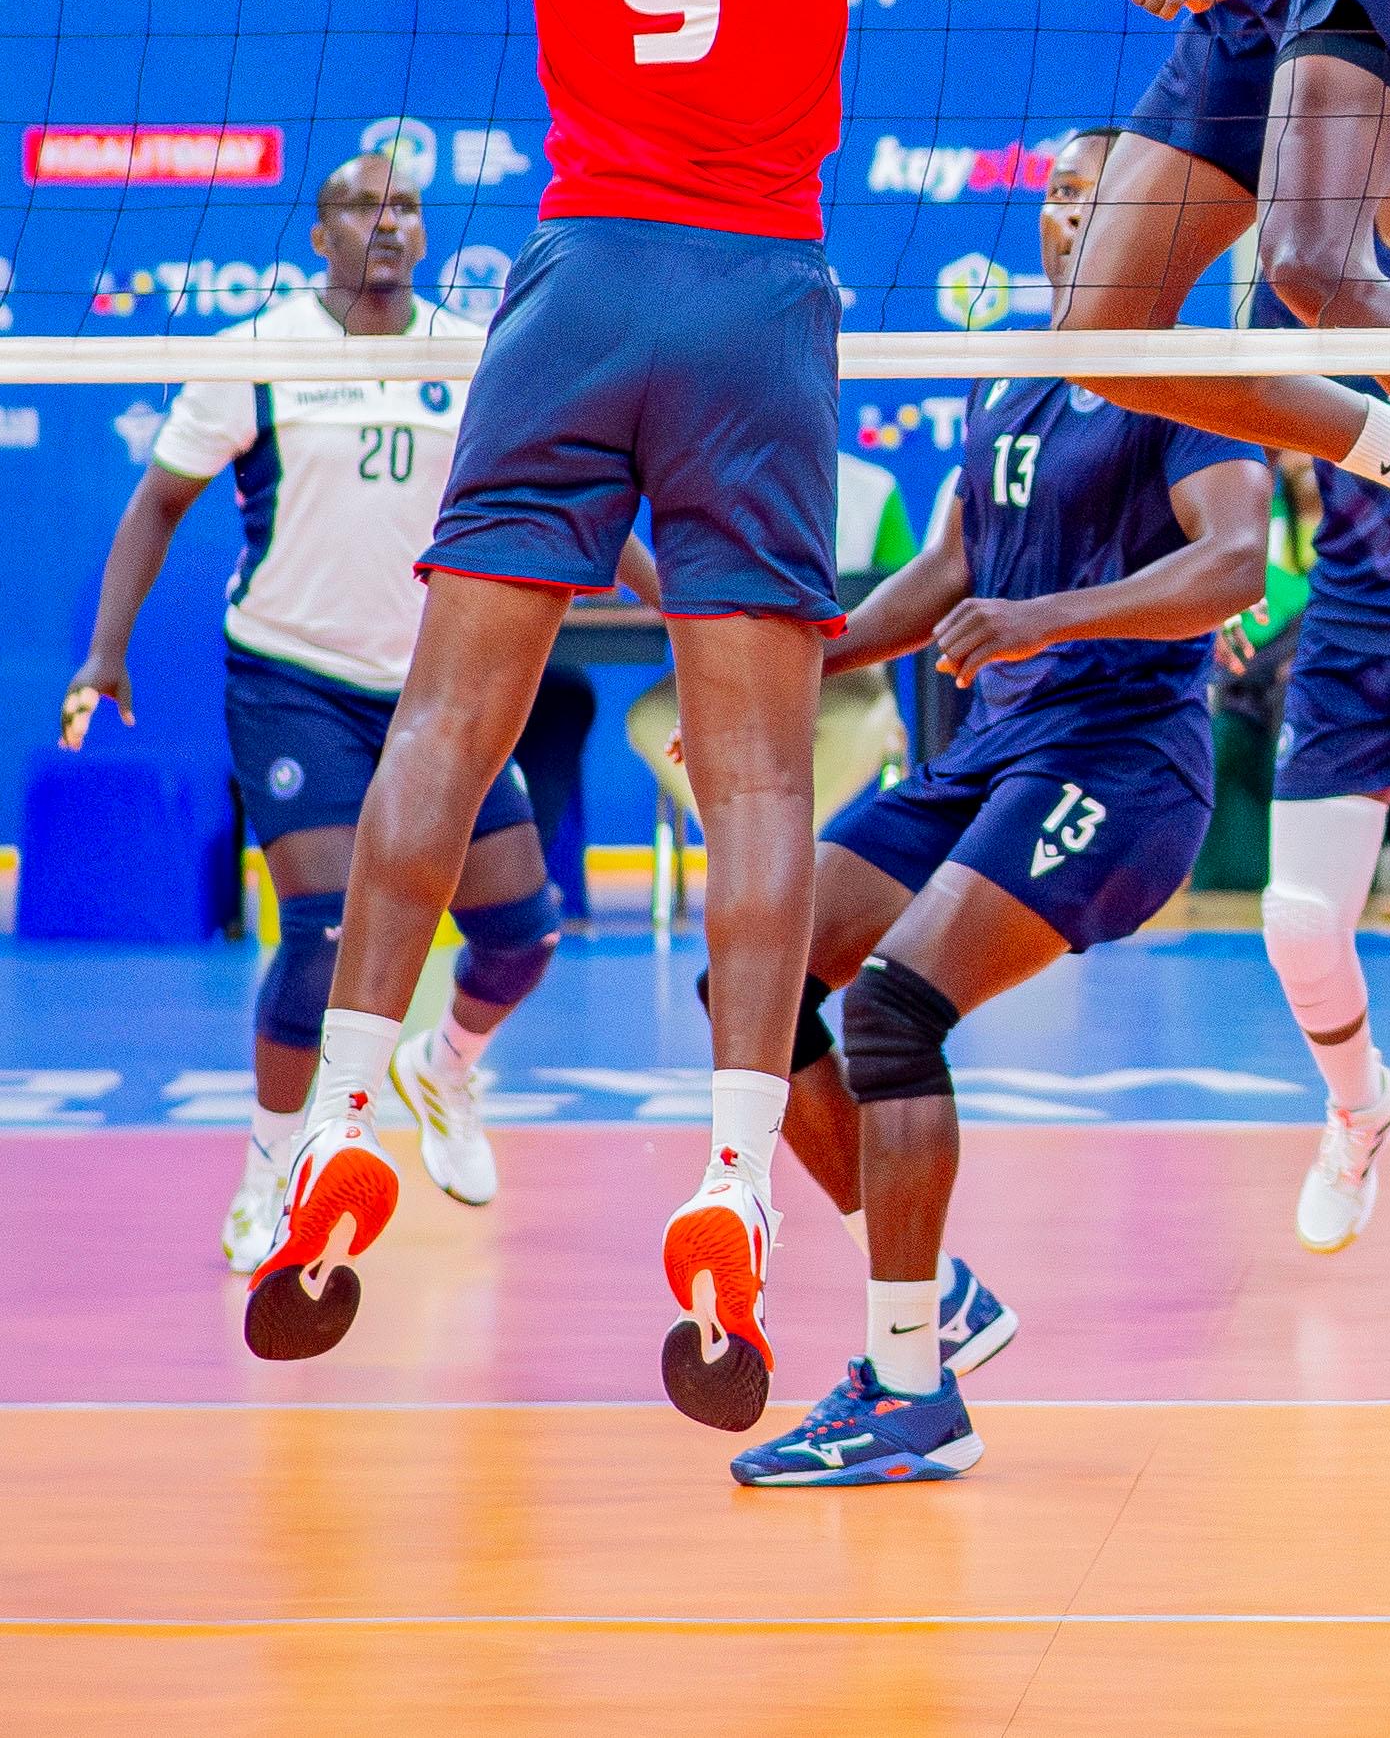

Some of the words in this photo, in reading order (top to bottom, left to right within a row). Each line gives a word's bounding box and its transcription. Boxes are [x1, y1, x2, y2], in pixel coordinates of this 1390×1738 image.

[359, 425, 415, 483] 20
[994, 434, 1041, 508] 13
[1042, 783, 1107, 852] 13
